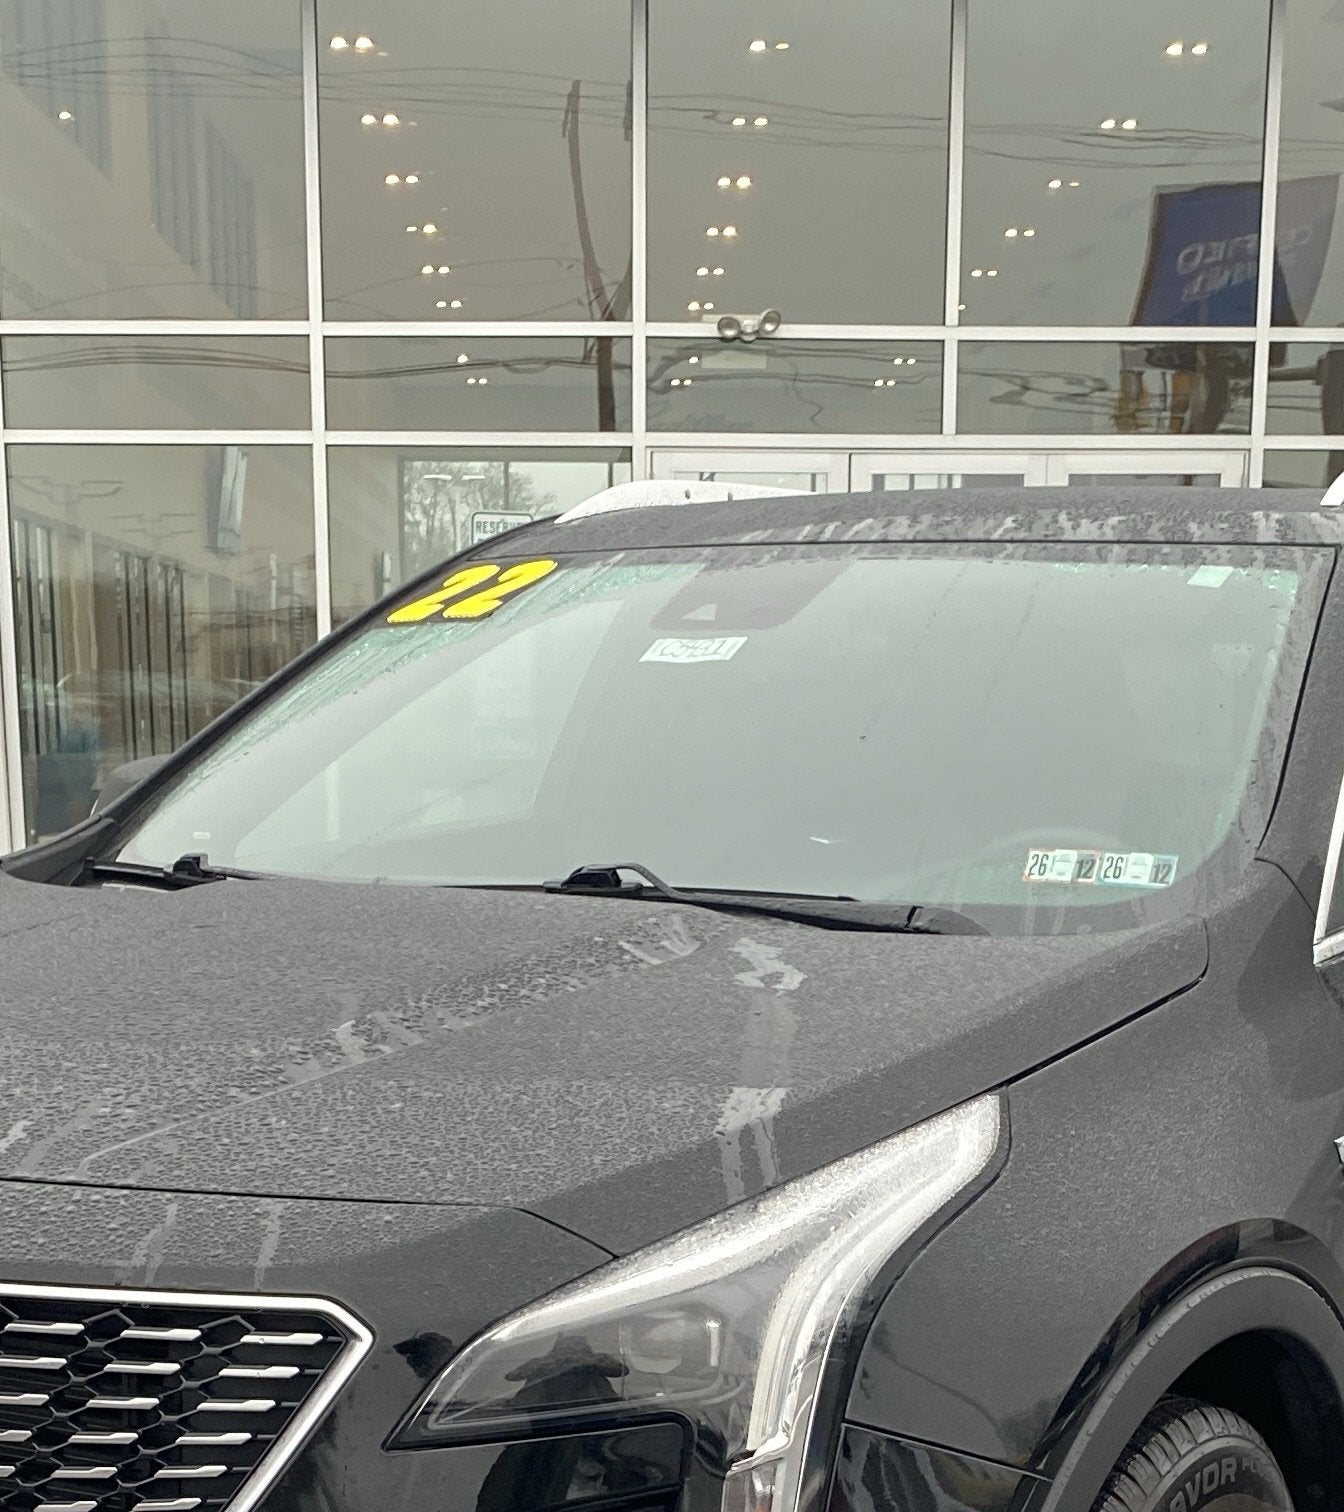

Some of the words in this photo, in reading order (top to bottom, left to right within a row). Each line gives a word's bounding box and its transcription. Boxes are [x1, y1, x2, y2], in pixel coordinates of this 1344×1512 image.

[385, 558, 559, 625] 22
[1027, 853, 1049, 877] 26
[1076, 858, 1096, 879] 12
[1103, 855, 1124, 879] 26
[1153, 863, 1173, 885] 12
